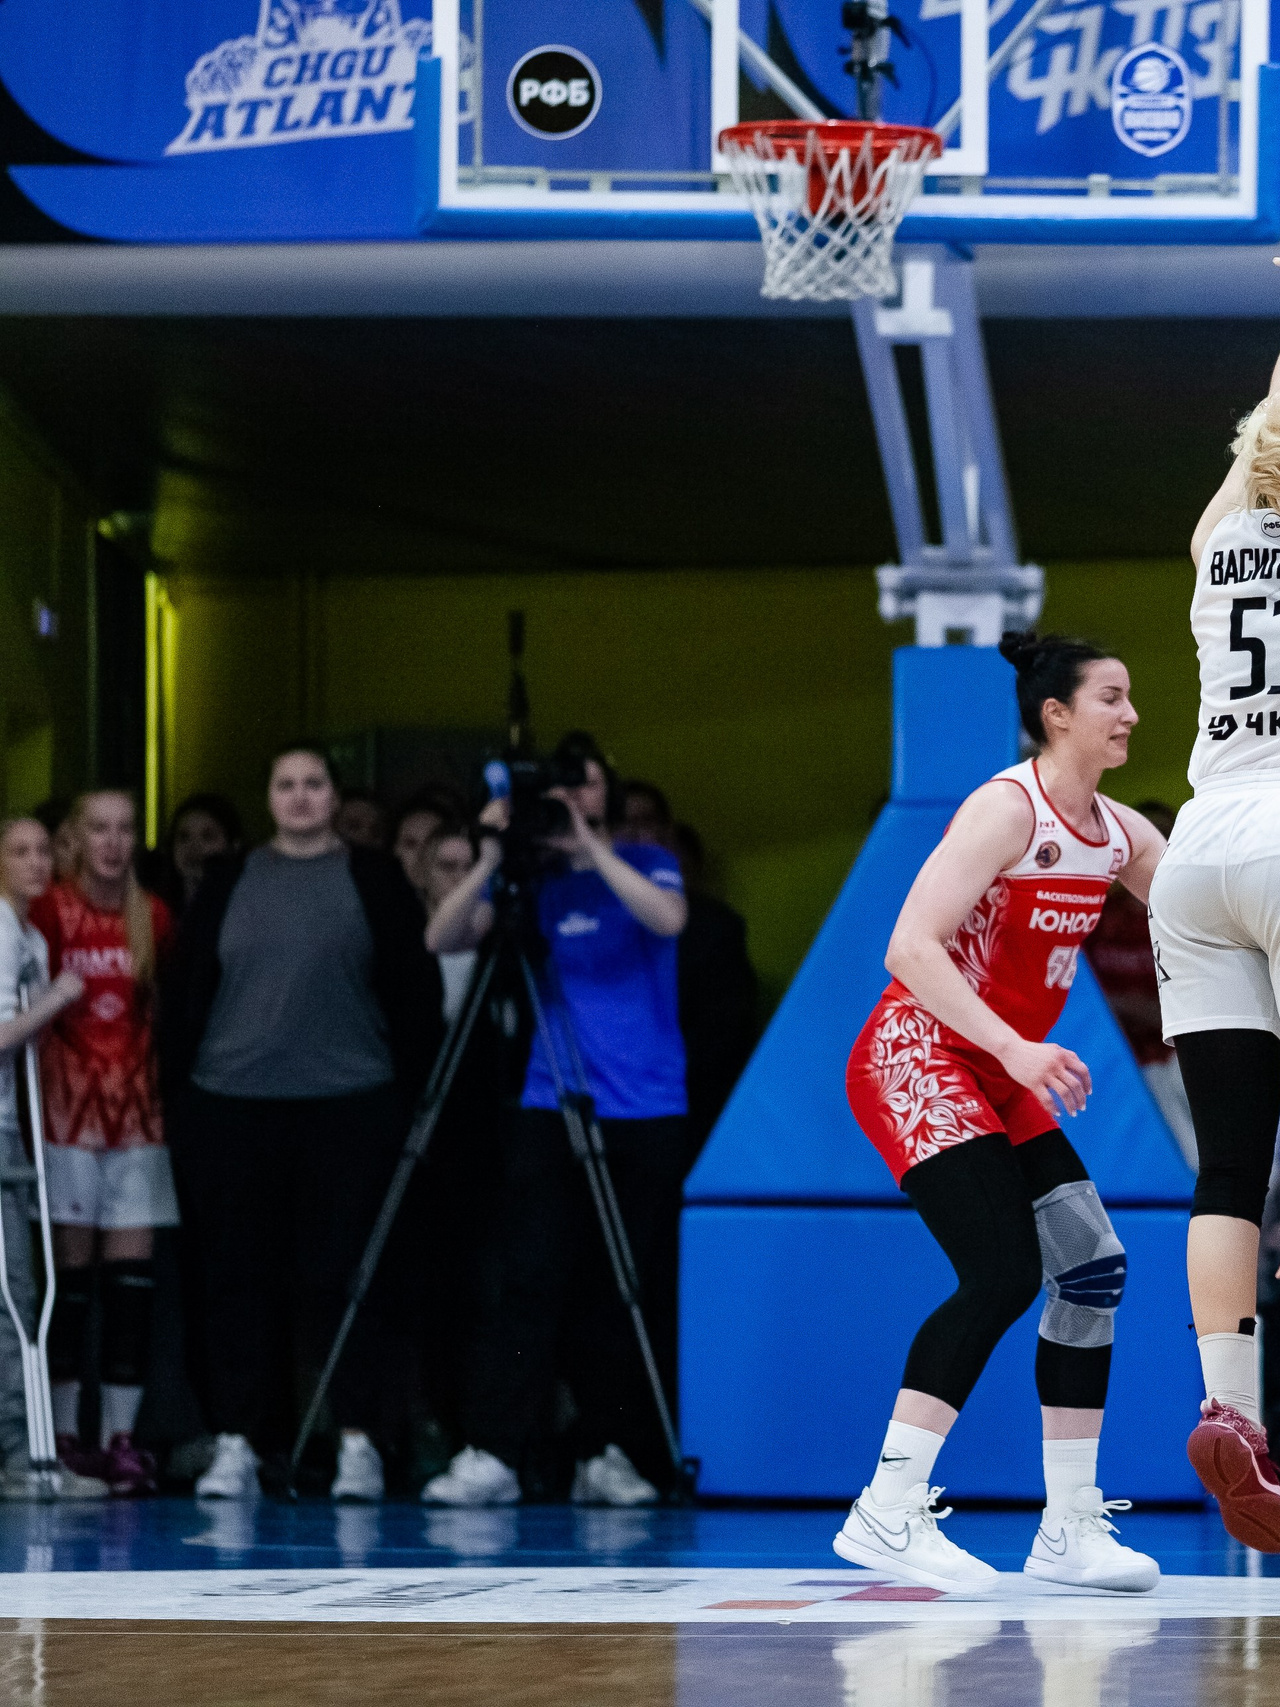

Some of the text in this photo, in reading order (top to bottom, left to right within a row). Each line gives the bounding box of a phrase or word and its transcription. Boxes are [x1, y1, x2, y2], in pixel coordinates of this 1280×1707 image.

[263, 44, 396, 90] CHGU
[519, 79, 590, 107] РФБ
[186, 83, 416, 142] ATLAN
[1263, 521, 1280, 530] РФБ
[1029, 907, 1101, 934] ЮНОС
